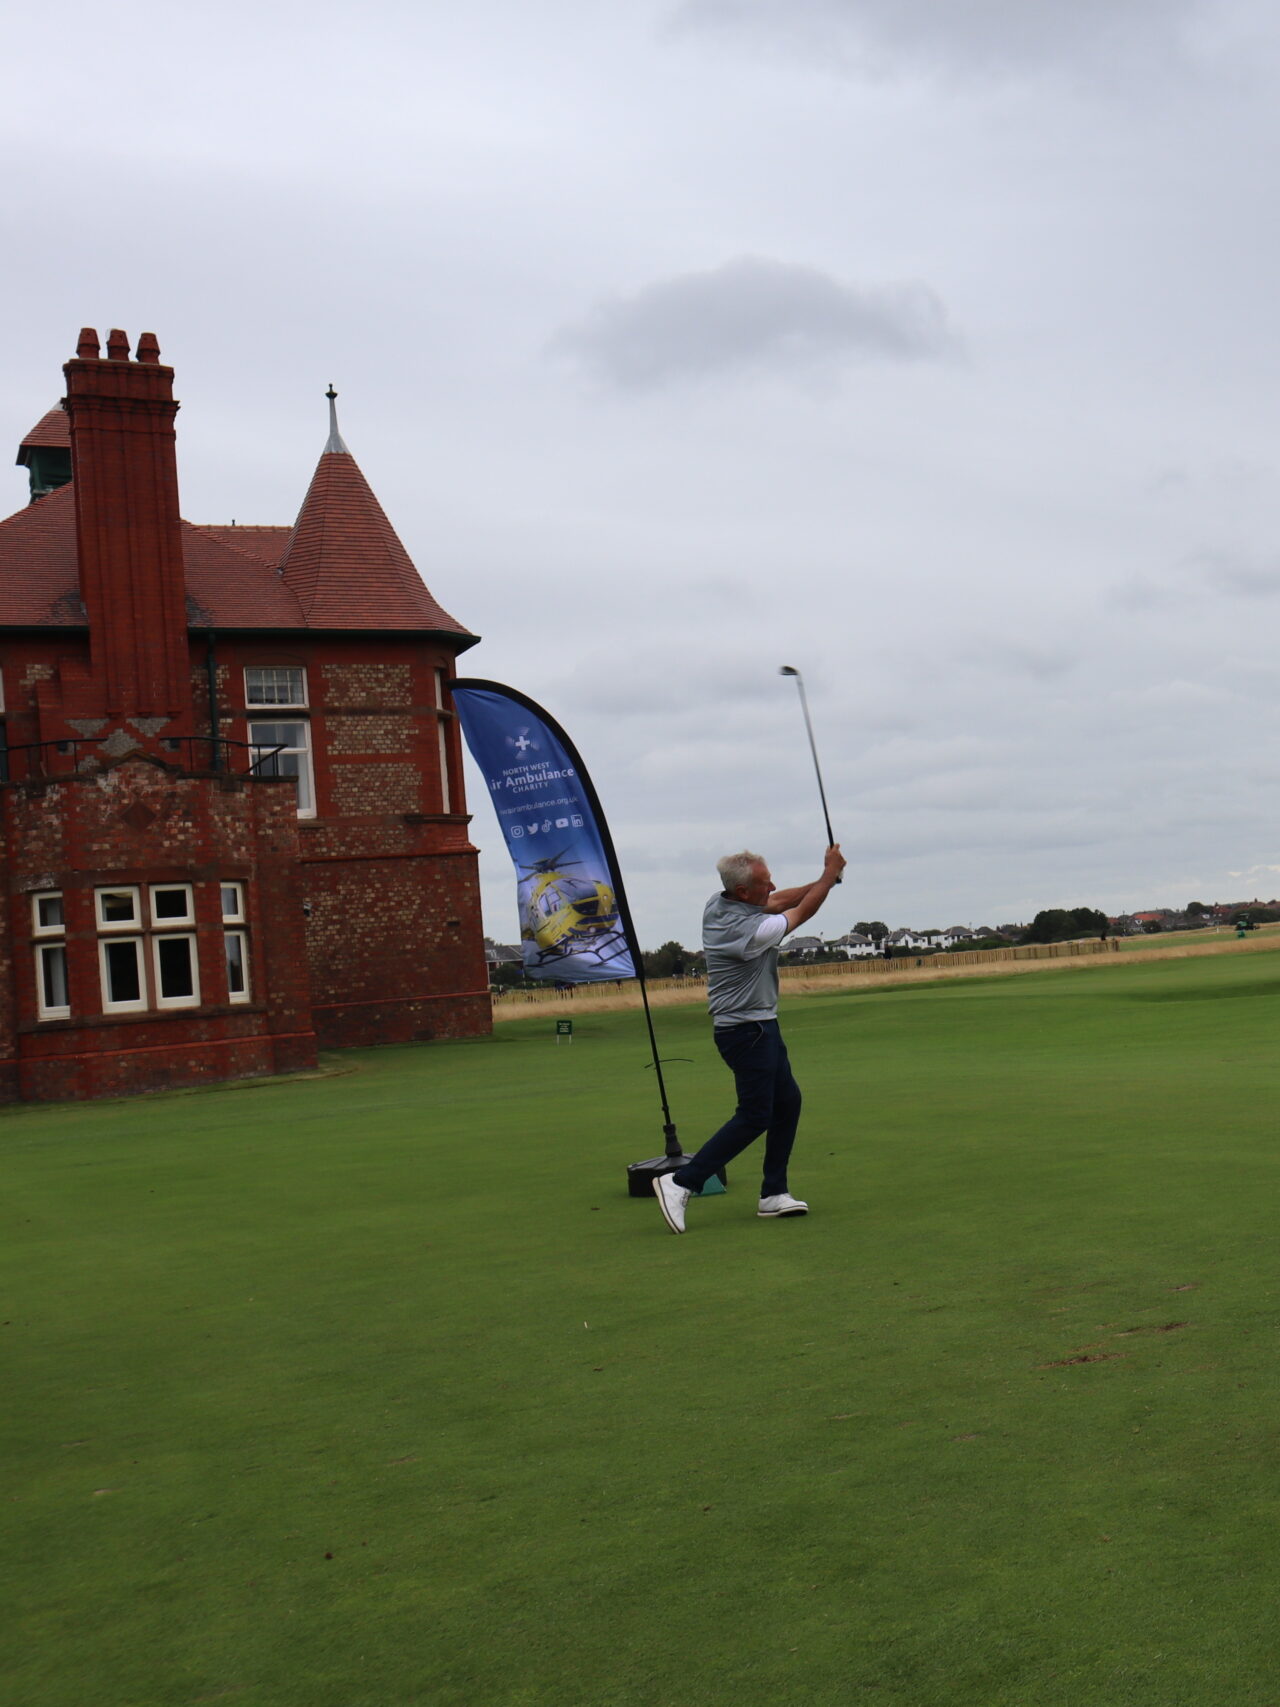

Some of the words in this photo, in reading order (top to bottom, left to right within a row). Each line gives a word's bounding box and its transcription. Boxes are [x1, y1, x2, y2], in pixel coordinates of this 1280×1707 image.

[503, 766, 528, 776] NORTH
[530, 761, 550, 771] WEST
[489, 779, 502, 790] ir
[506, 769, 574, 788] Ambulance
[512, 781, 549, 793] CHARITY
